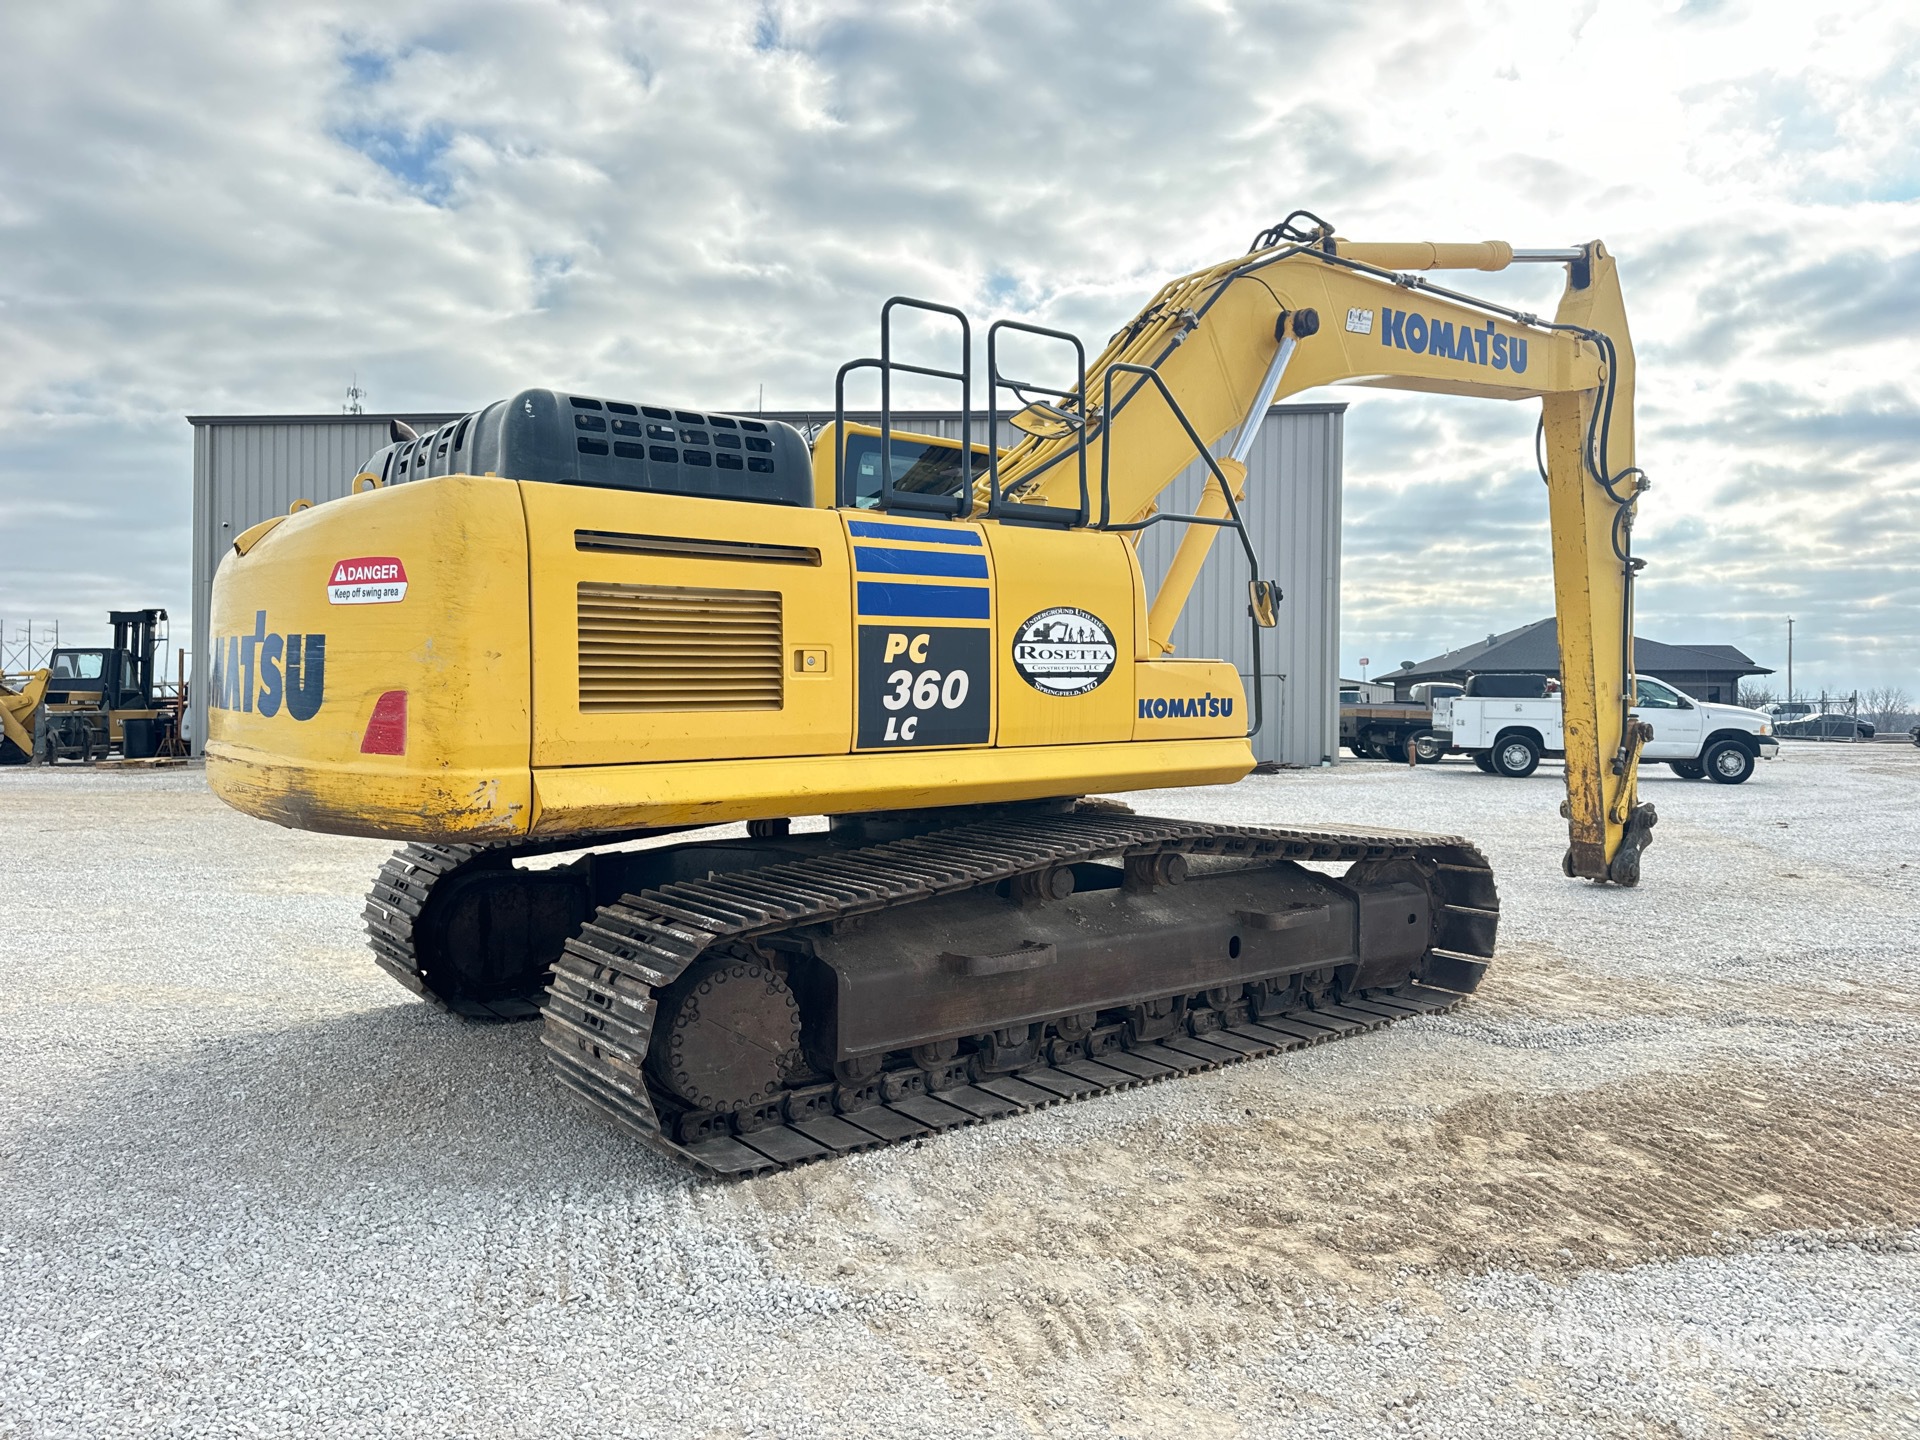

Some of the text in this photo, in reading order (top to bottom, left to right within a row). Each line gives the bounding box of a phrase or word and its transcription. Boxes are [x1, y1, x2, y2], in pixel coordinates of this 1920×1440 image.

[1382, 307, 1527, 374] KOMATSU
[347, 564, 398, 581] DANGER
[334, 587, 399, 599] Keep off swing area
[1022, 608, 1106, 632] UNDERGROUND UTILITIES
[883, 633, 930, 664] PC
[1018, 645, 1112, 660] ROSETTA
[882, 669, 969, 711] 360
[1082, 681, 1098, 693] MO
[1138, 692, 1233, 719] KOMATSU
[883, 716, 918, 741] LC
